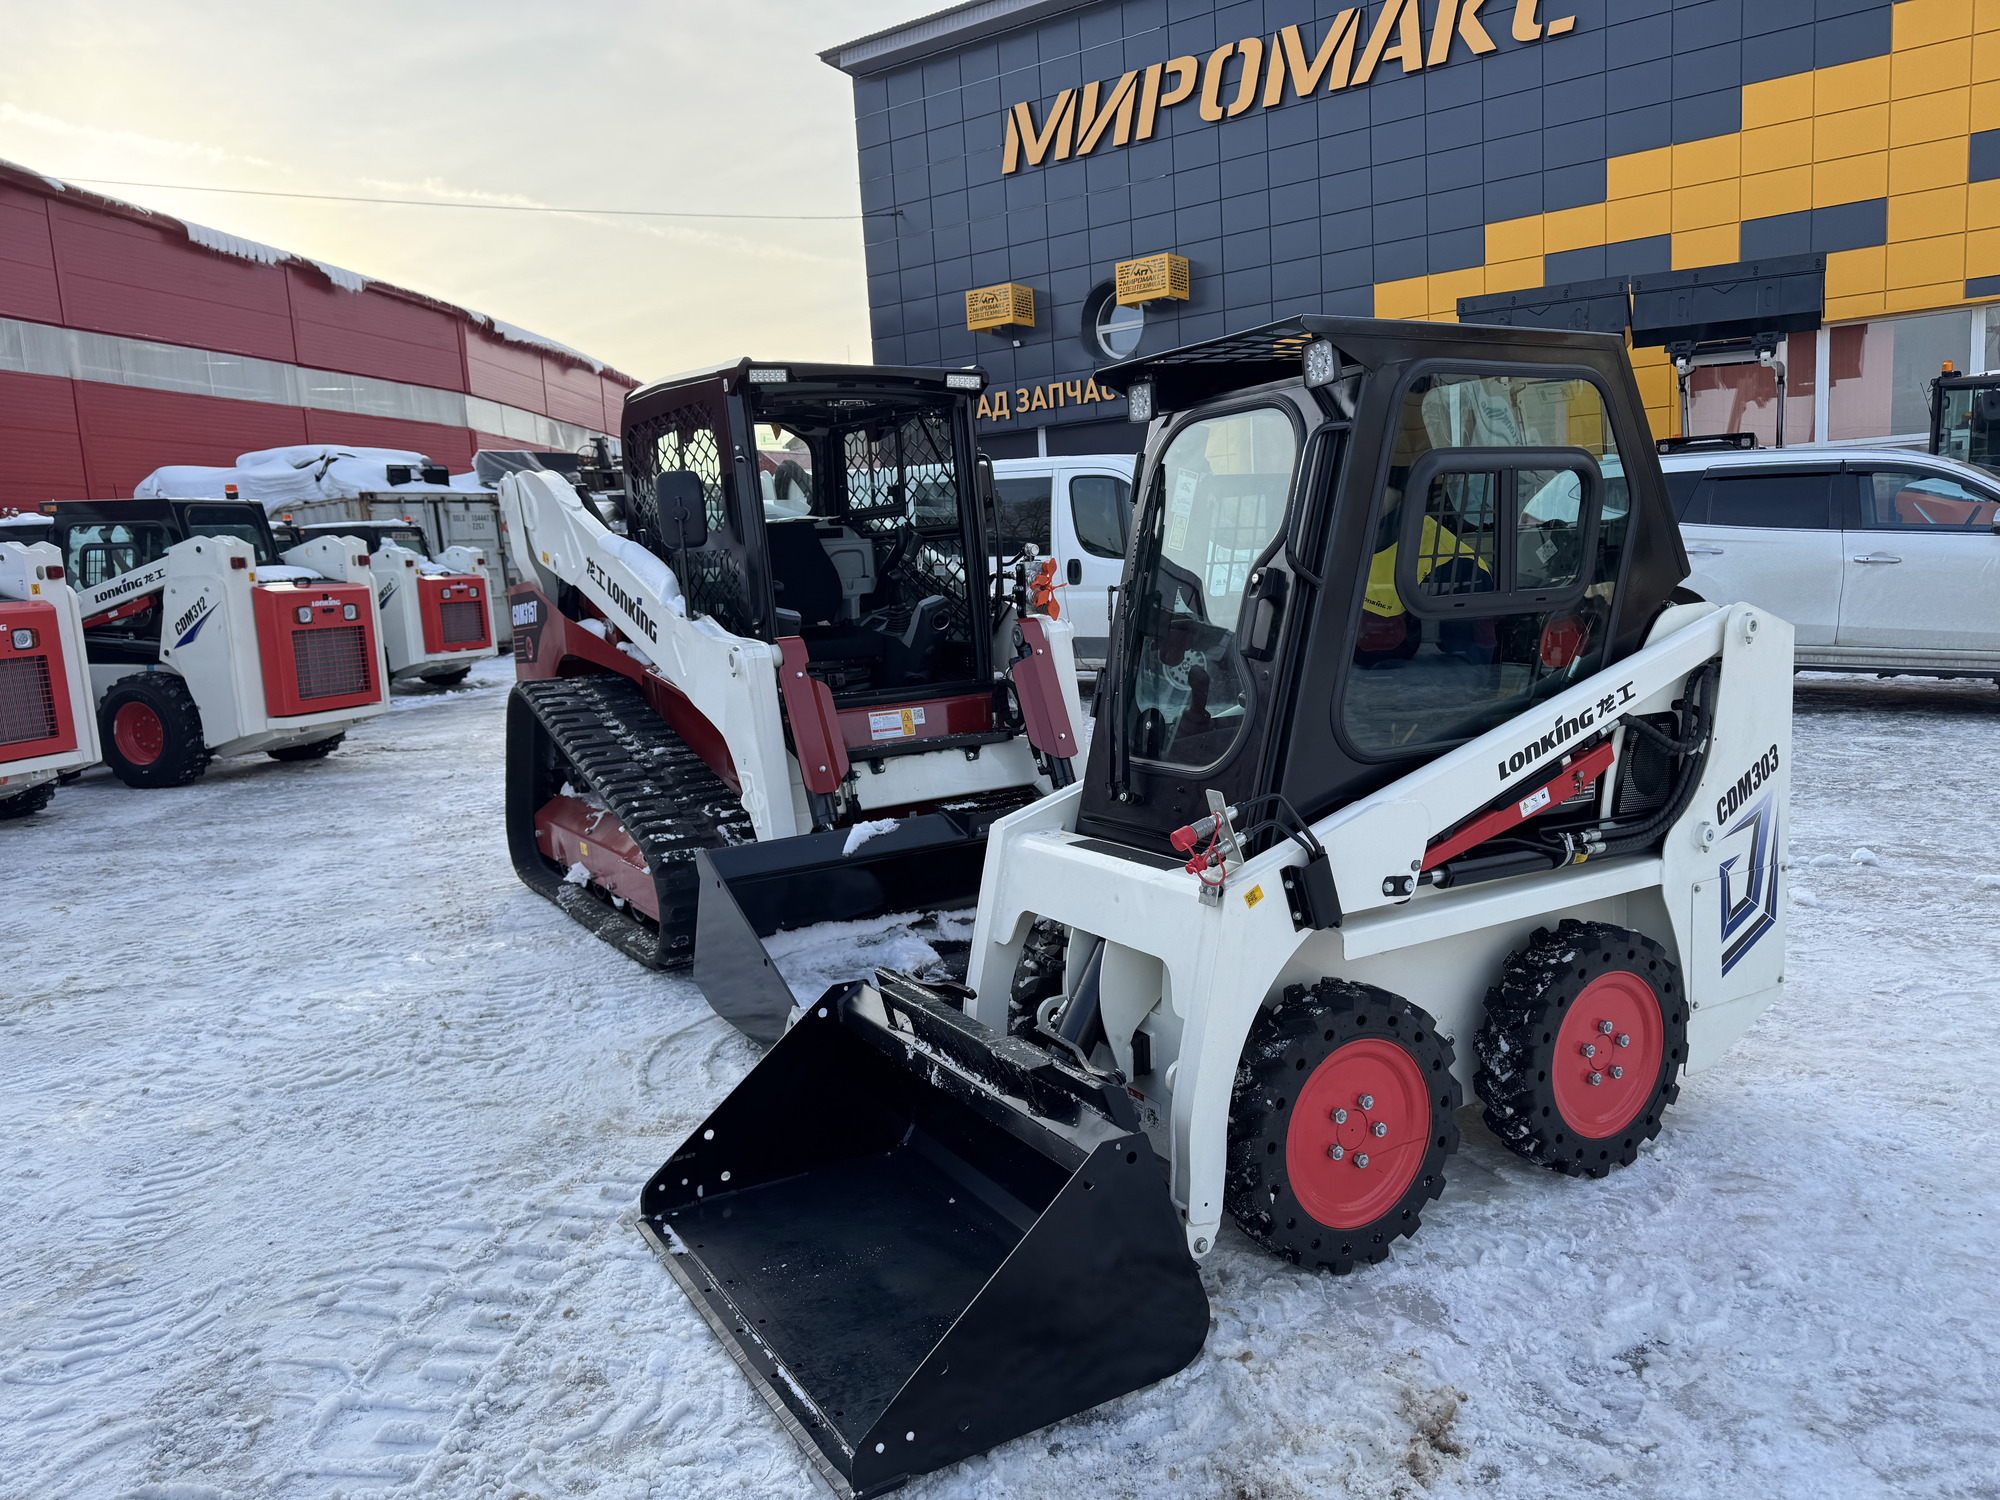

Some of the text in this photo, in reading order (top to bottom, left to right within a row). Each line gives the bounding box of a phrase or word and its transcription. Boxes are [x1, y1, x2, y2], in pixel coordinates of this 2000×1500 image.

[1016, 377, 1125, 413] ЗАПЧАС
[144, 568, 166, 585] 龙工
[586, 556, 606, 592] 龙工
[174, 596, 208, 636] CDM312
[512, 600, 537, 627] CDM315T
[1596, 680, 1637, 719] 龙工
[1716, 743, 1779, 826] CDM303
